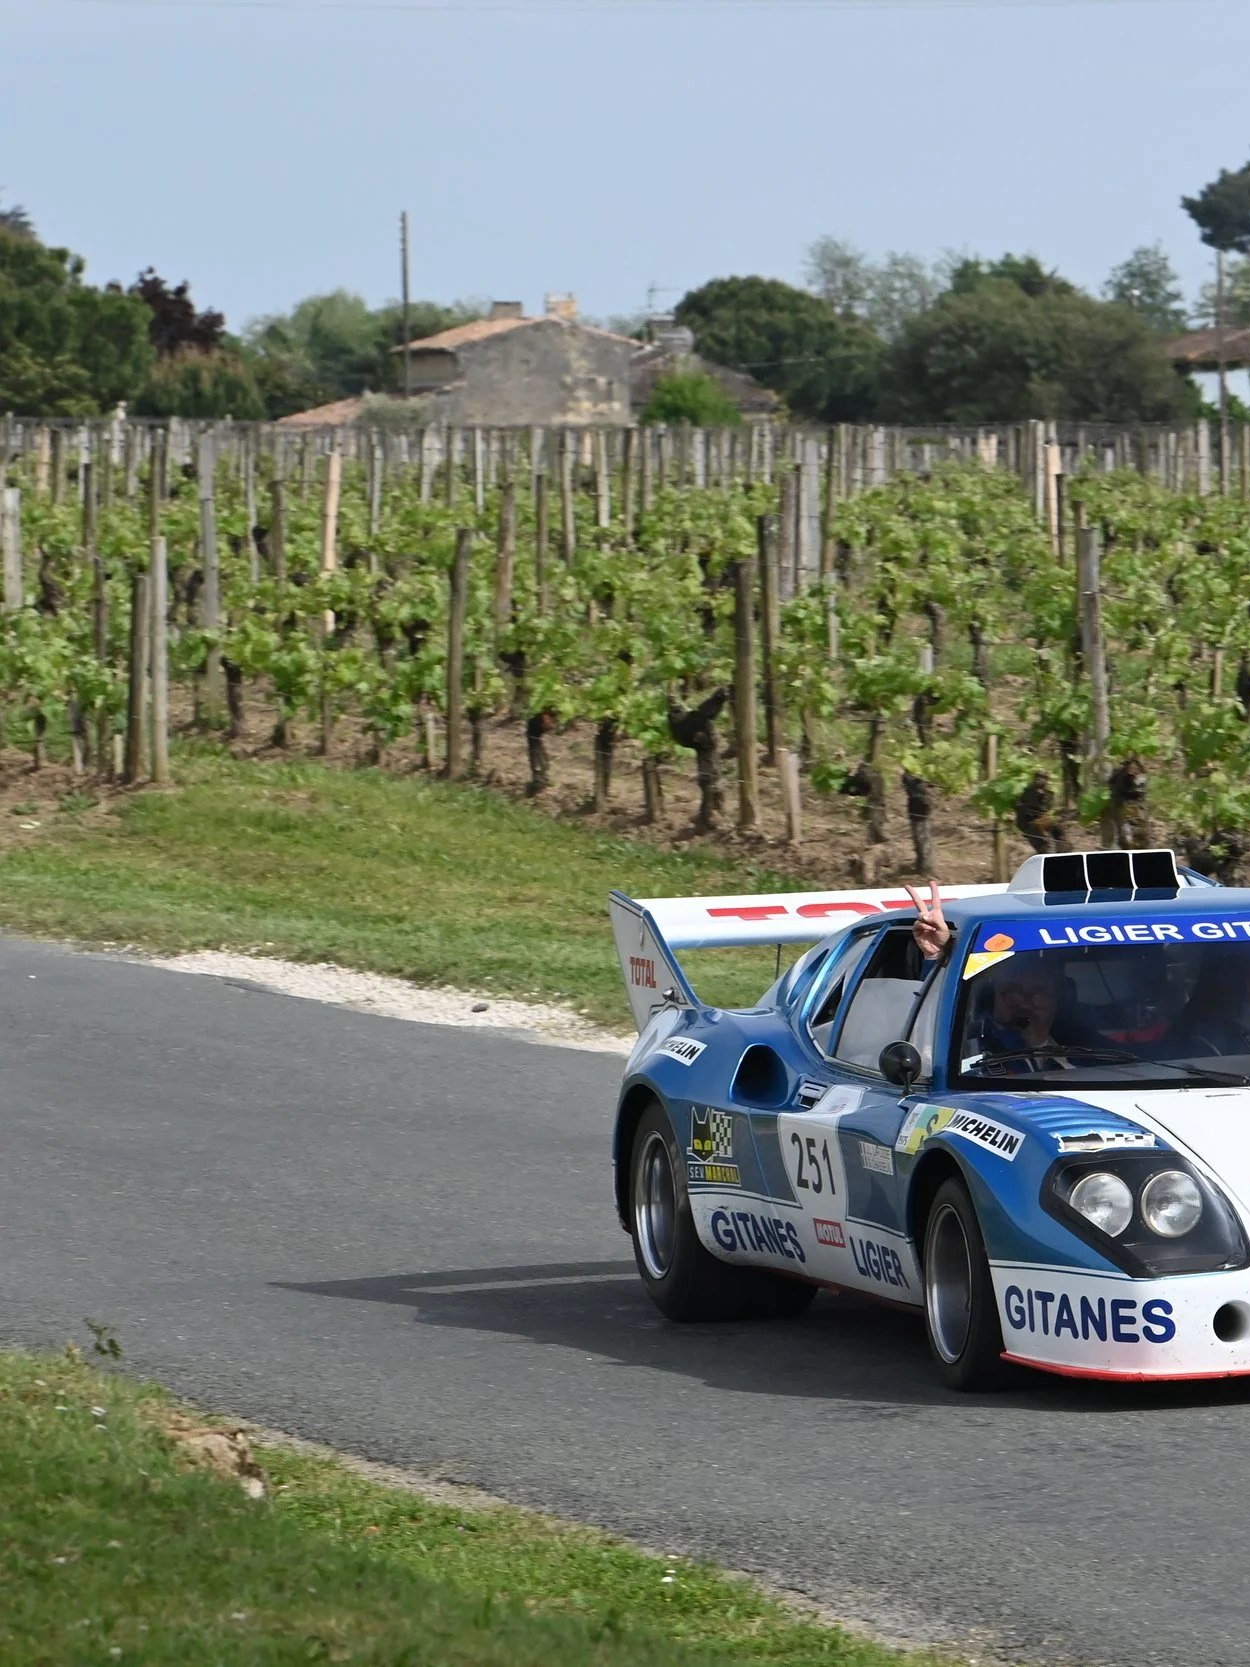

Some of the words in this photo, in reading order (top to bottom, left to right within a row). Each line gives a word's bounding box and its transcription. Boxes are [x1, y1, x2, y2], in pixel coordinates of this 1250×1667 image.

[1039, 923, 1184, 945] LIGIER
[630, 956, 657, 989] TOTAL
[951, 1114, 1020, 1154] MICHELIN
[790, 1132, 837, 1196] 251
[711, 1210, 806, 1263] GITANES
[816, 1222, 843, 1245] MOTUL
[849, 1236, 911, 1290] LIGIER
[1005, 1285, 1177, 1344] GITANES
